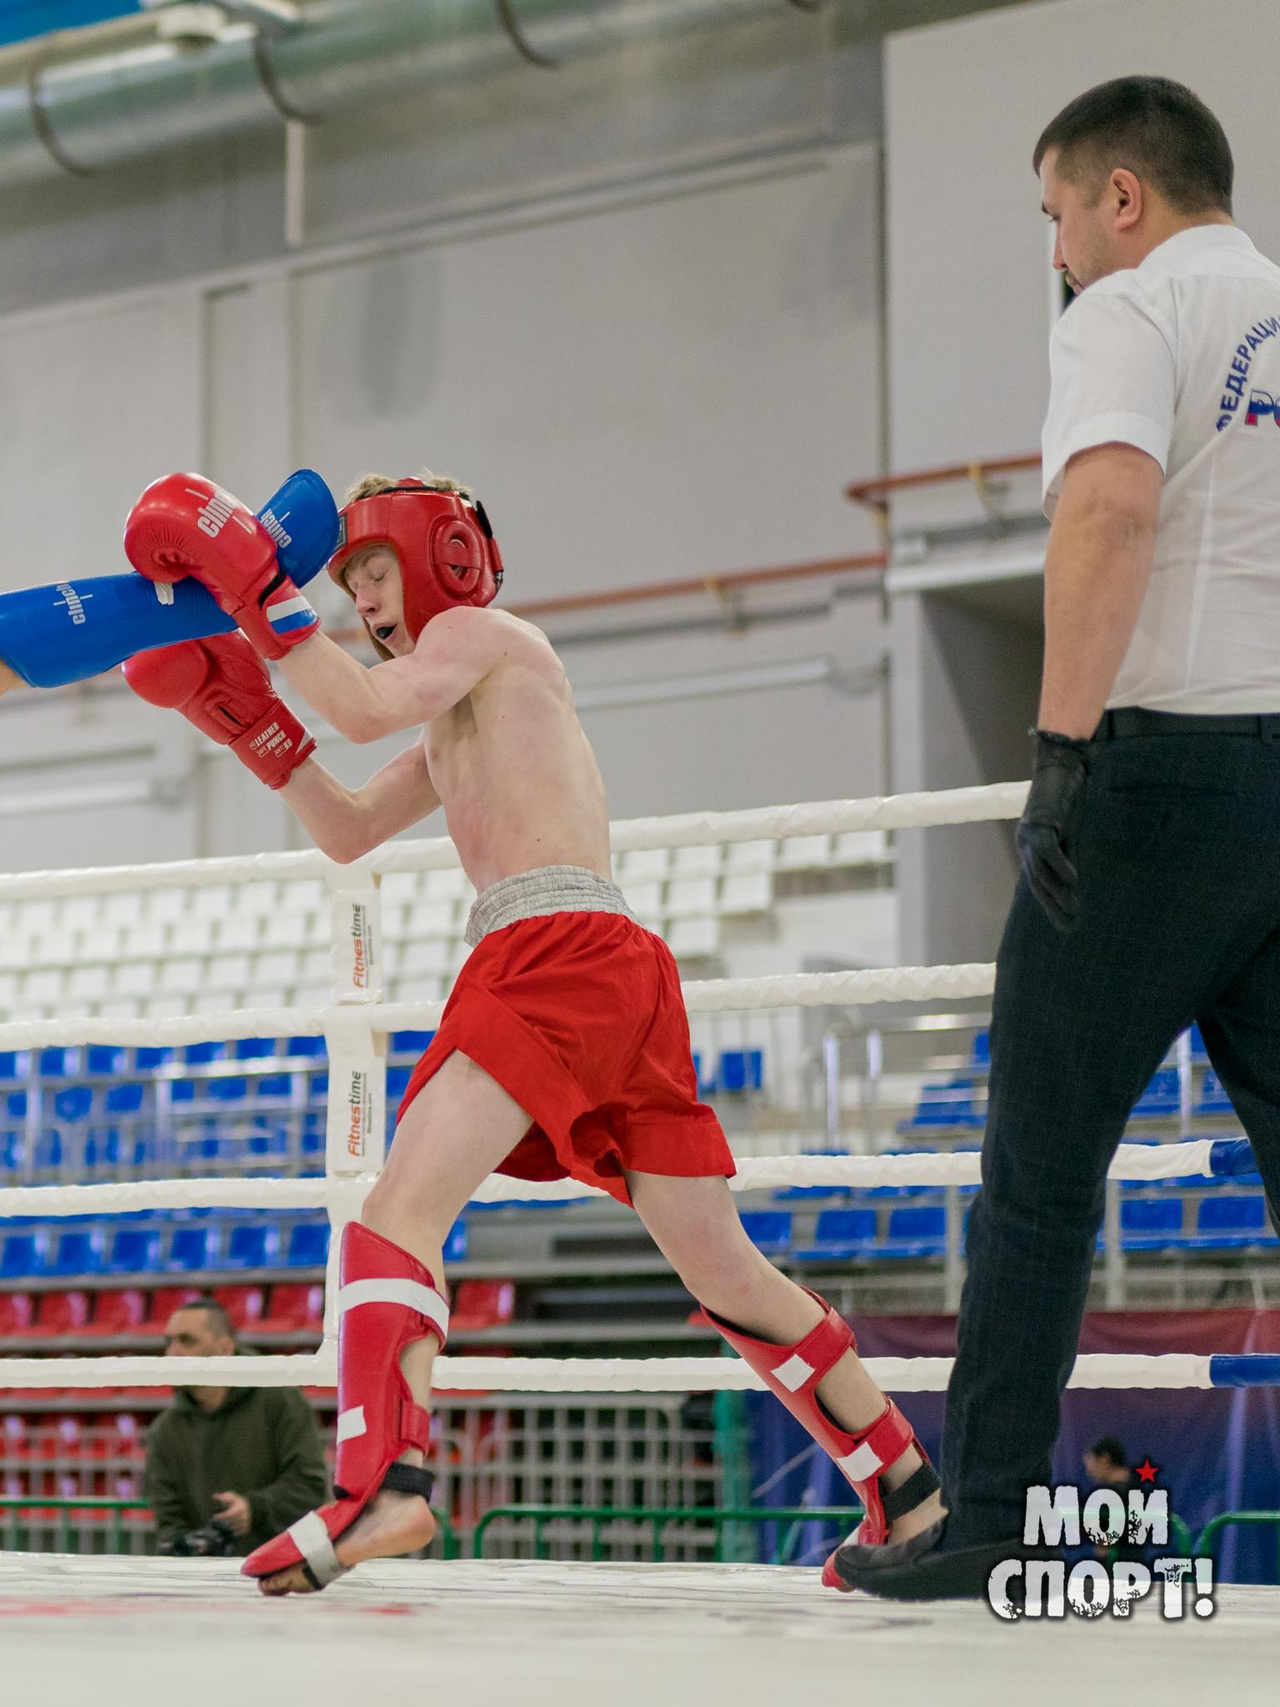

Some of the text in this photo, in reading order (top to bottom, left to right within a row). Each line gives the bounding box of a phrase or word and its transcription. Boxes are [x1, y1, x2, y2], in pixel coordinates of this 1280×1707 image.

[197, 489, 238, 538] clin
[260, 508, 292, 549] clinch
[254, 722, 280, 747] LEATHER
[266, 730, 287, 751] PUNCH
[352, 903, 364, 989] Fitnestime
[347, 1071, 361, 1158] Fitnestime
